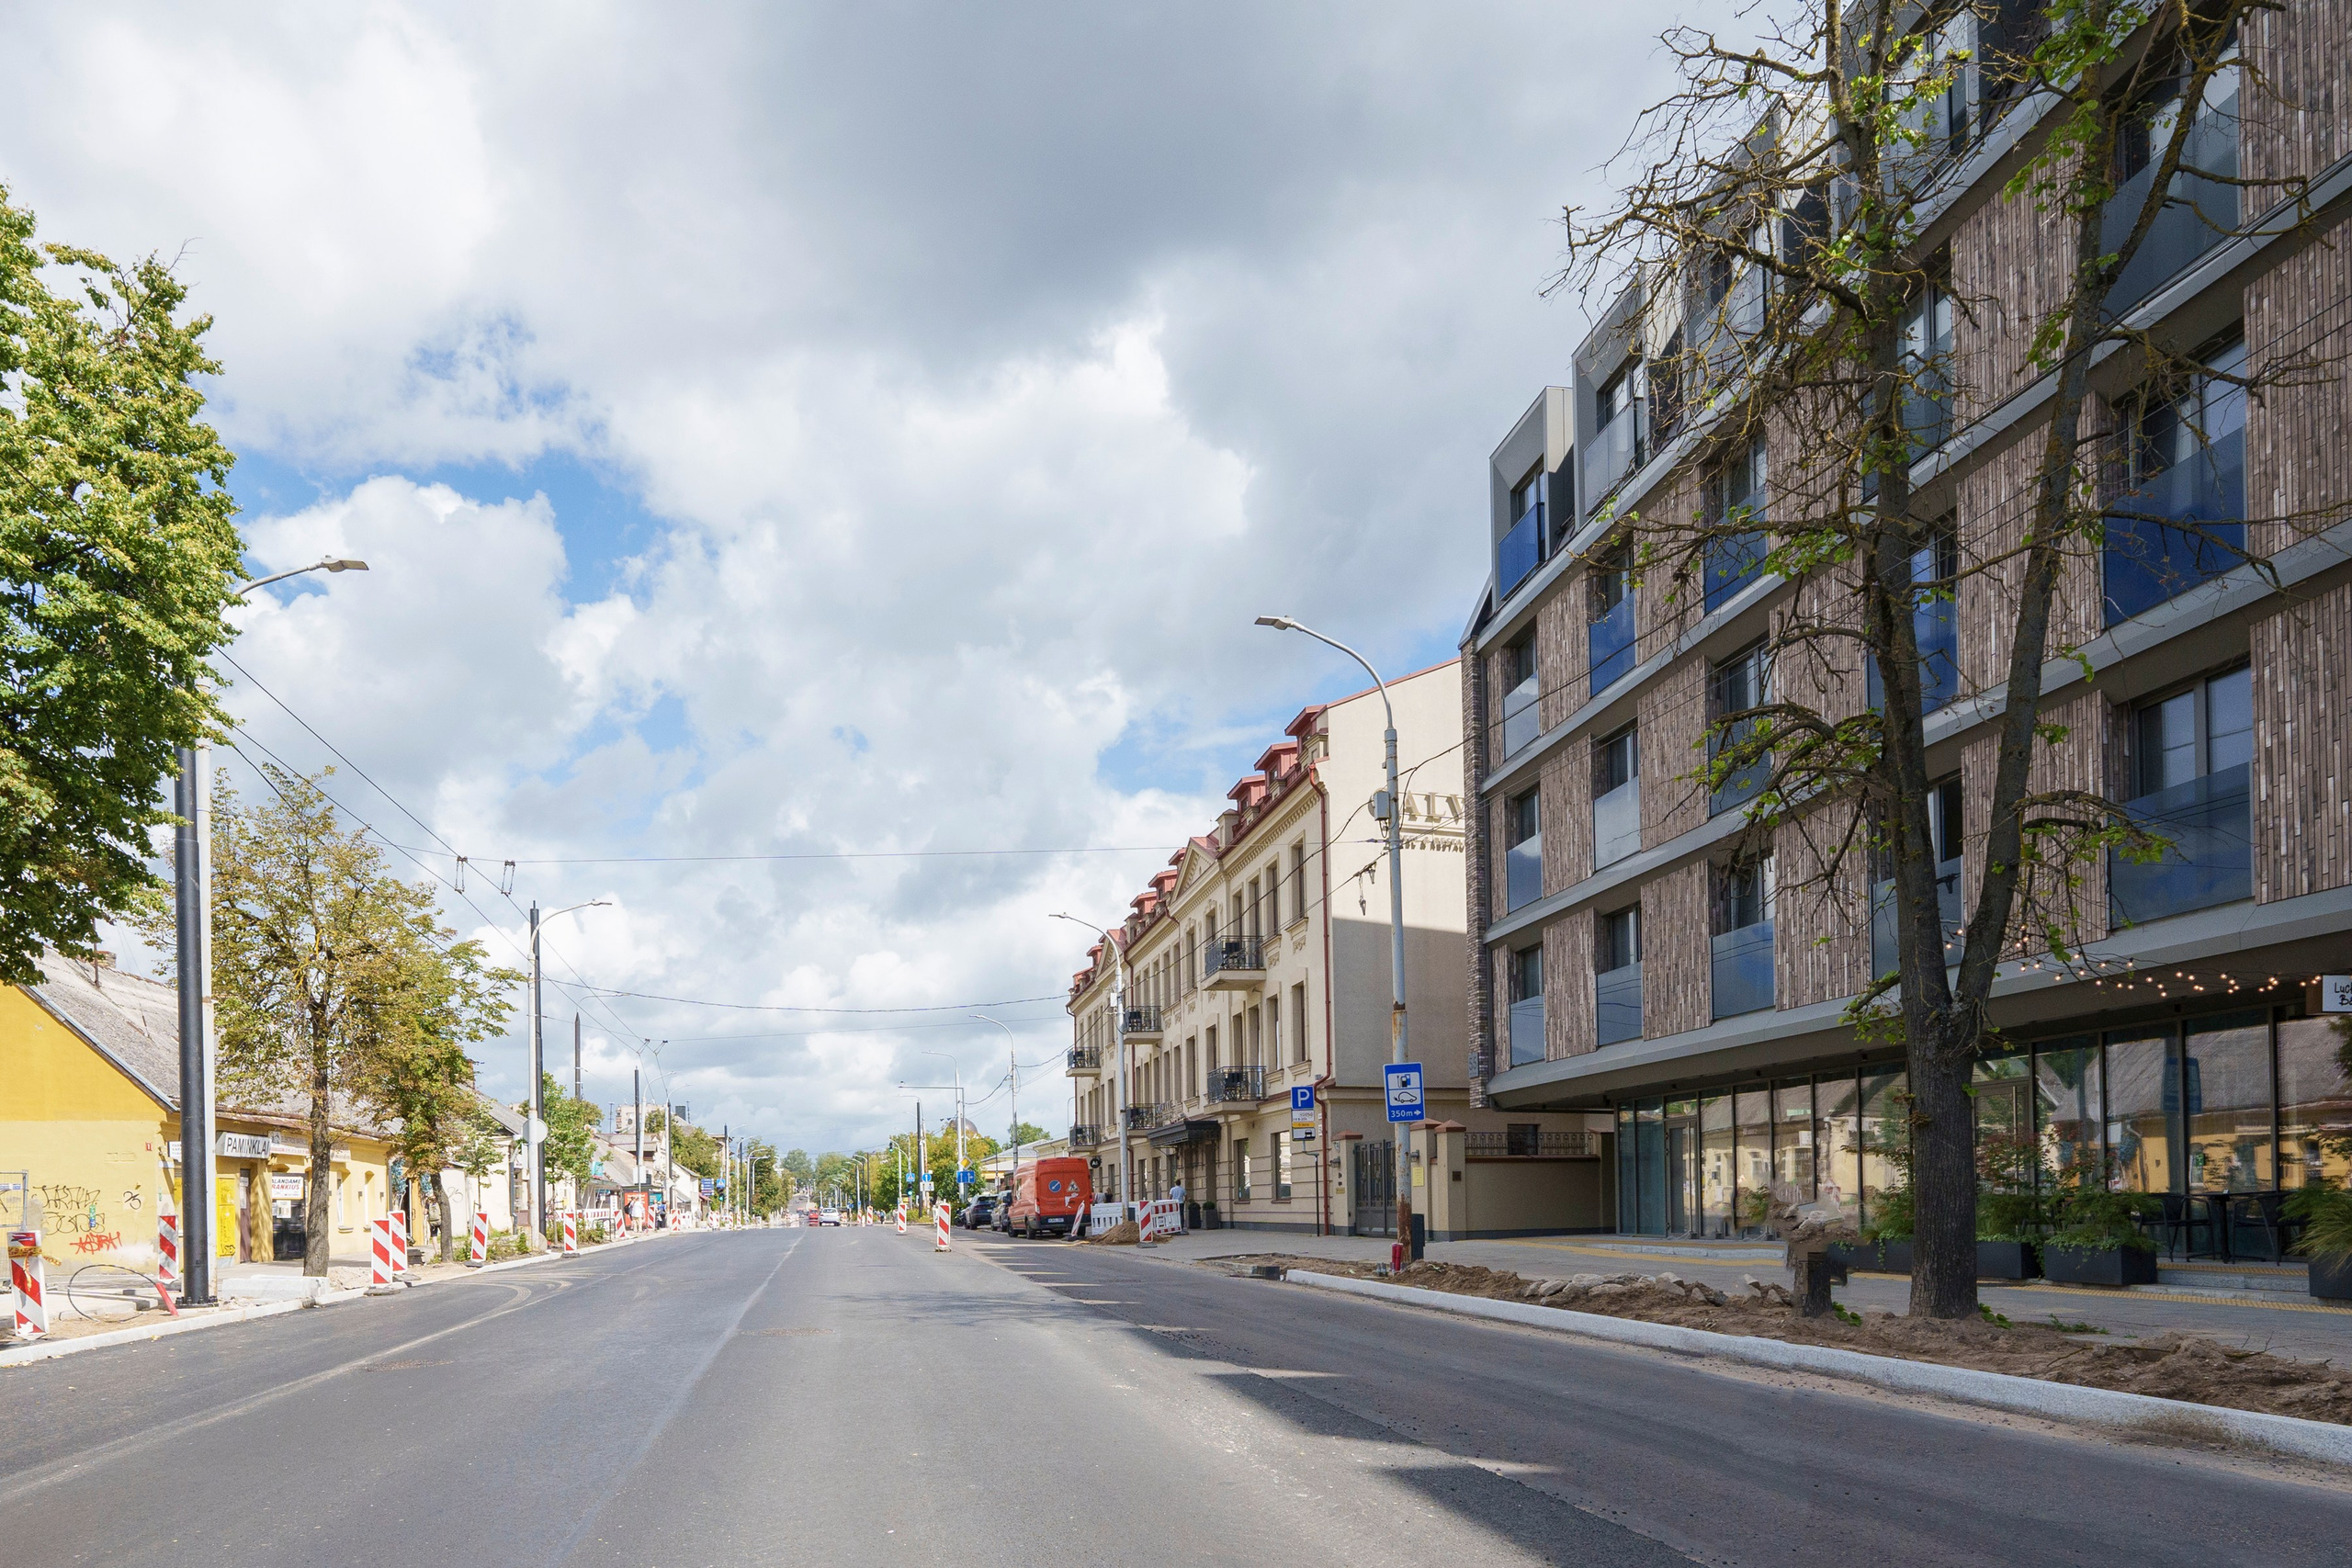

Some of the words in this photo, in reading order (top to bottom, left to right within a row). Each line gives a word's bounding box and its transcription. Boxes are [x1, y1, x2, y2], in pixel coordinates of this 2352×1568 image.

[2335, 983, 2352, 994] Luc
[1297, 1089, 1310, 1107] P
[226, 1137, 270, 1156] PAMINKLAI
